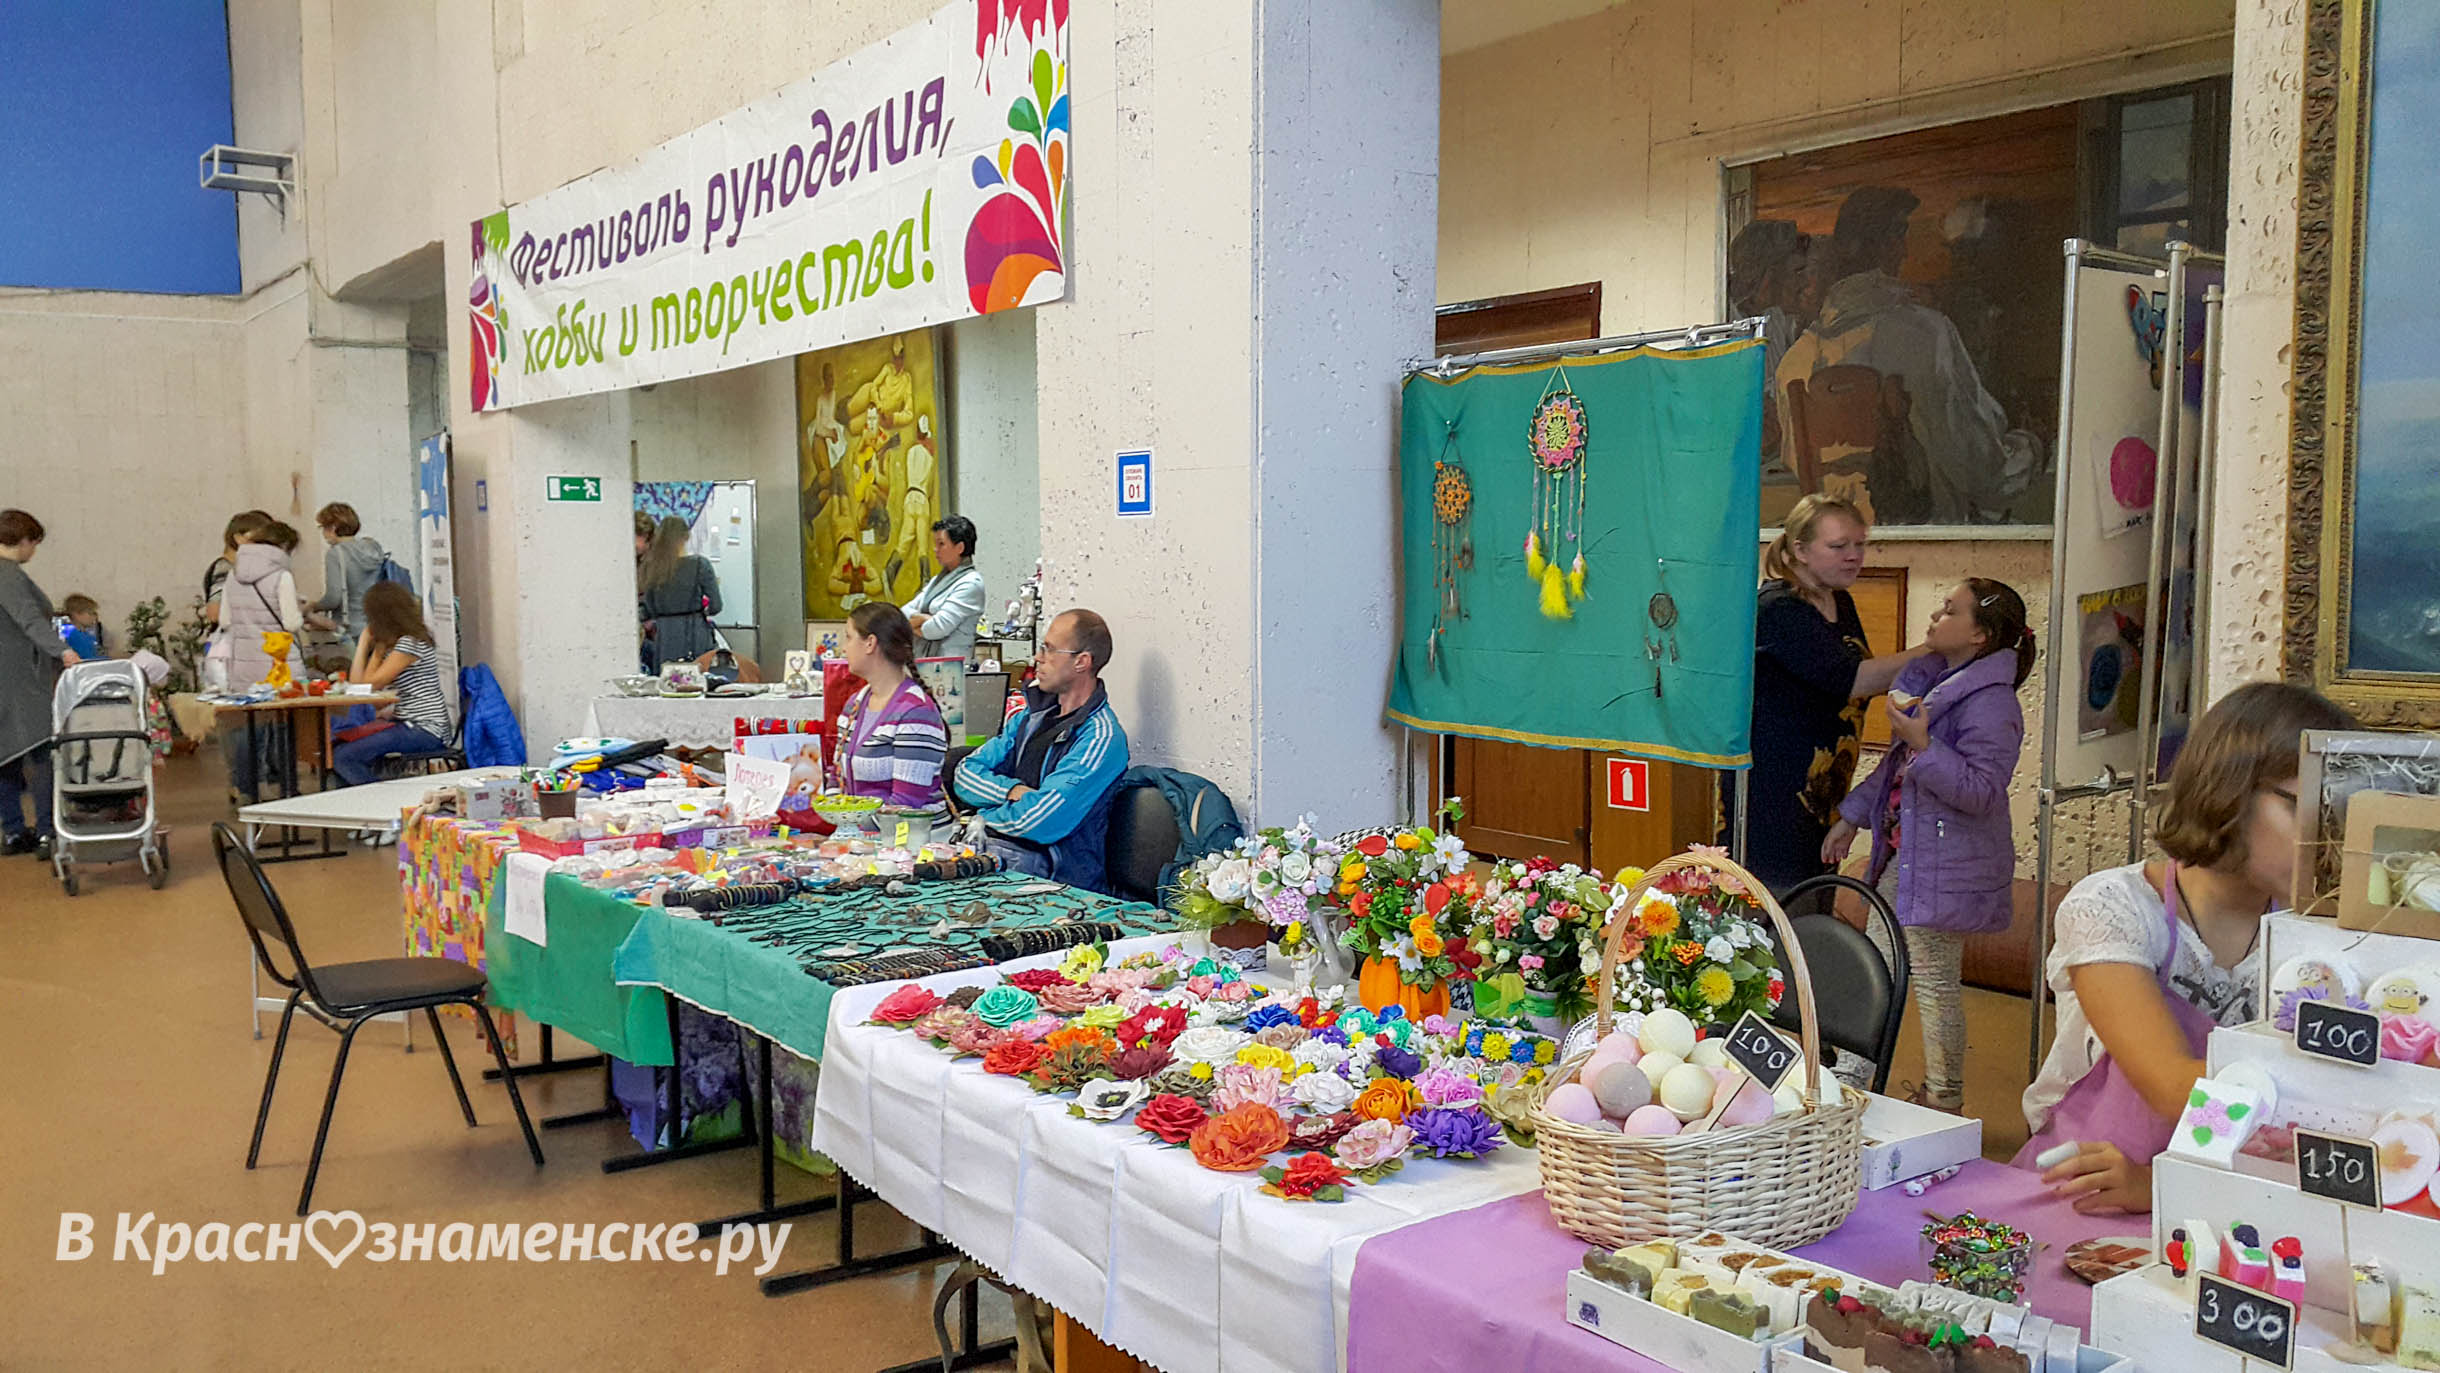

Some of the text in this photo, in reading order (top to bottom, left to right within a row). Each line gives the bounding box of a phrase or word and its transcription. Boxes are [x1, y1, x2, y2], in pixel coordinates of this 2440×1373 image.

[510, 76, 955, 290] Фестиваль рукоделия,
[522, 189, 934, 375] хобби и творчества!
[1128, 484, 1141, 498] 01
[1735, 1027, 1787, 1069] 100
[2306, 1019, 2373, 1056] 100
[2303, 1140, 2365, 1184] 150
